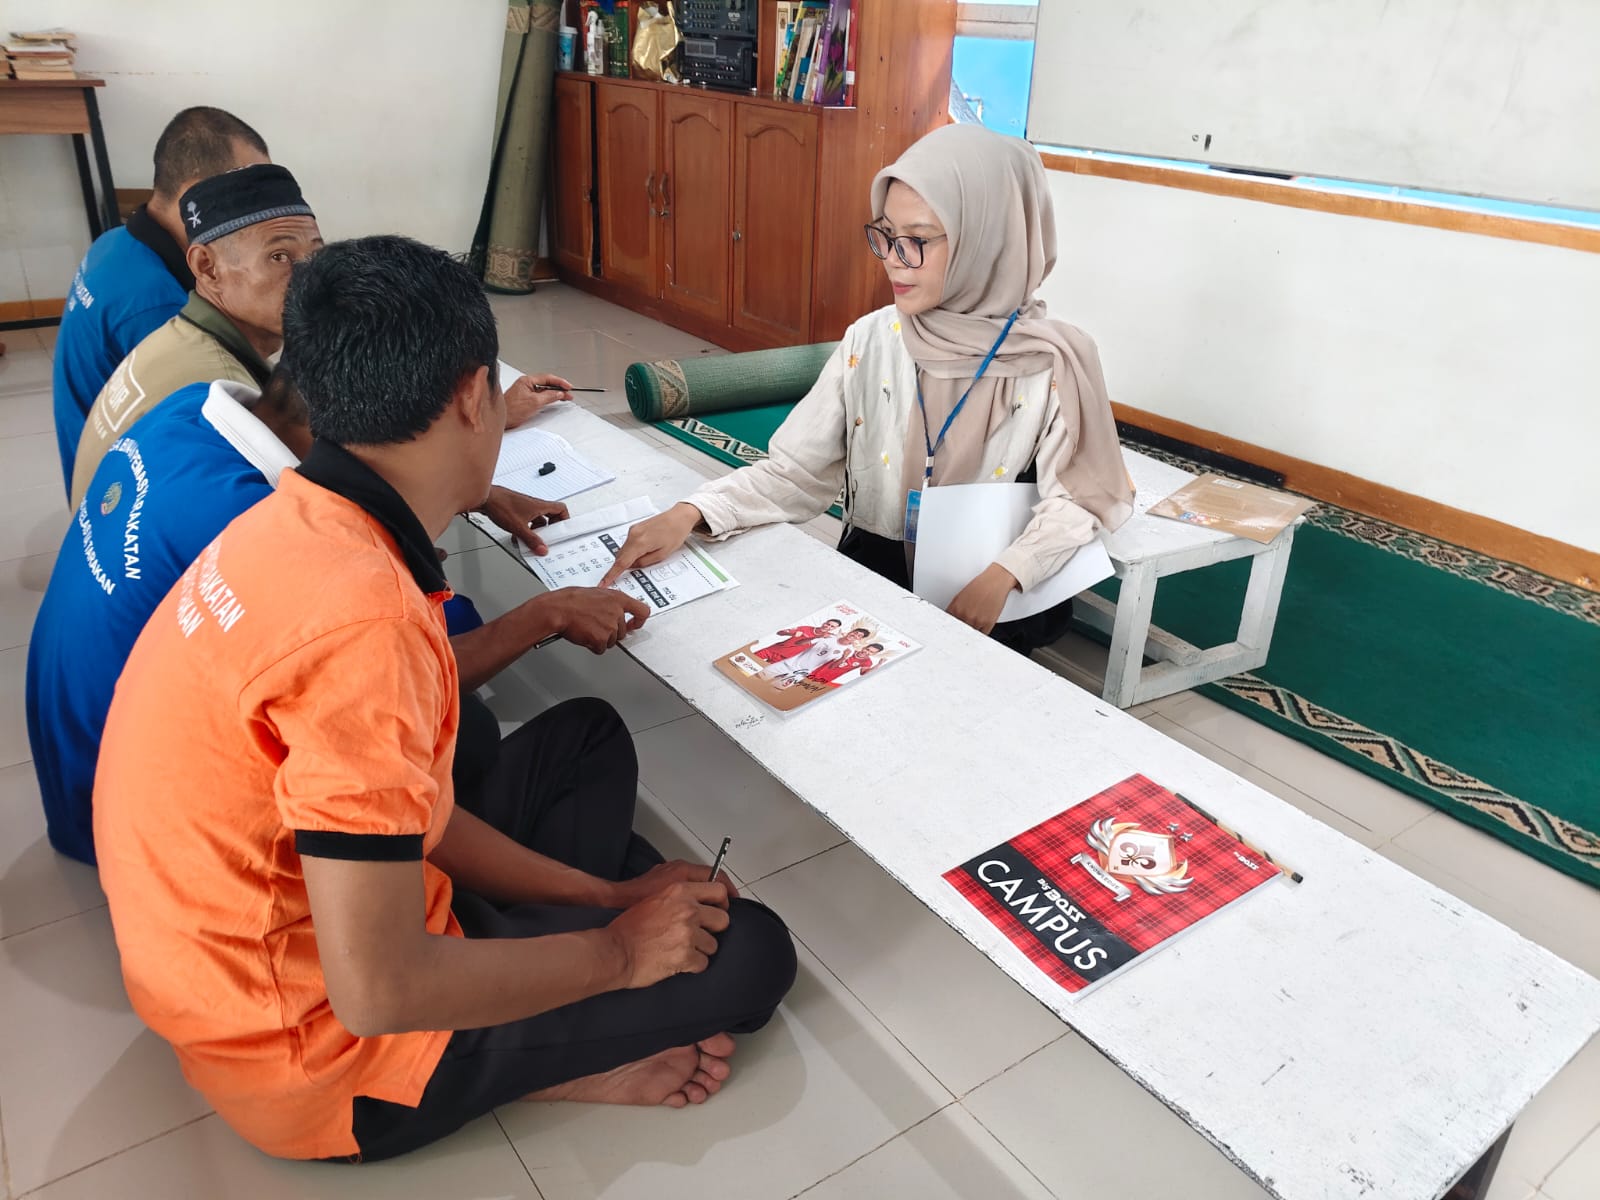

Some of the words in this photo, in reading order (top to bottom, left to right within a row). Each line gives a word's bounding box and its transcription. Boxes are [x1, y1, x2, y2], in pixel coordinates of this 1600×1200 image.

[85, 540, 116, 595] TARAKAN
[977, 860, 1108, 971] CAMPUS
[1045, 888, 1087, 924] BOSS
